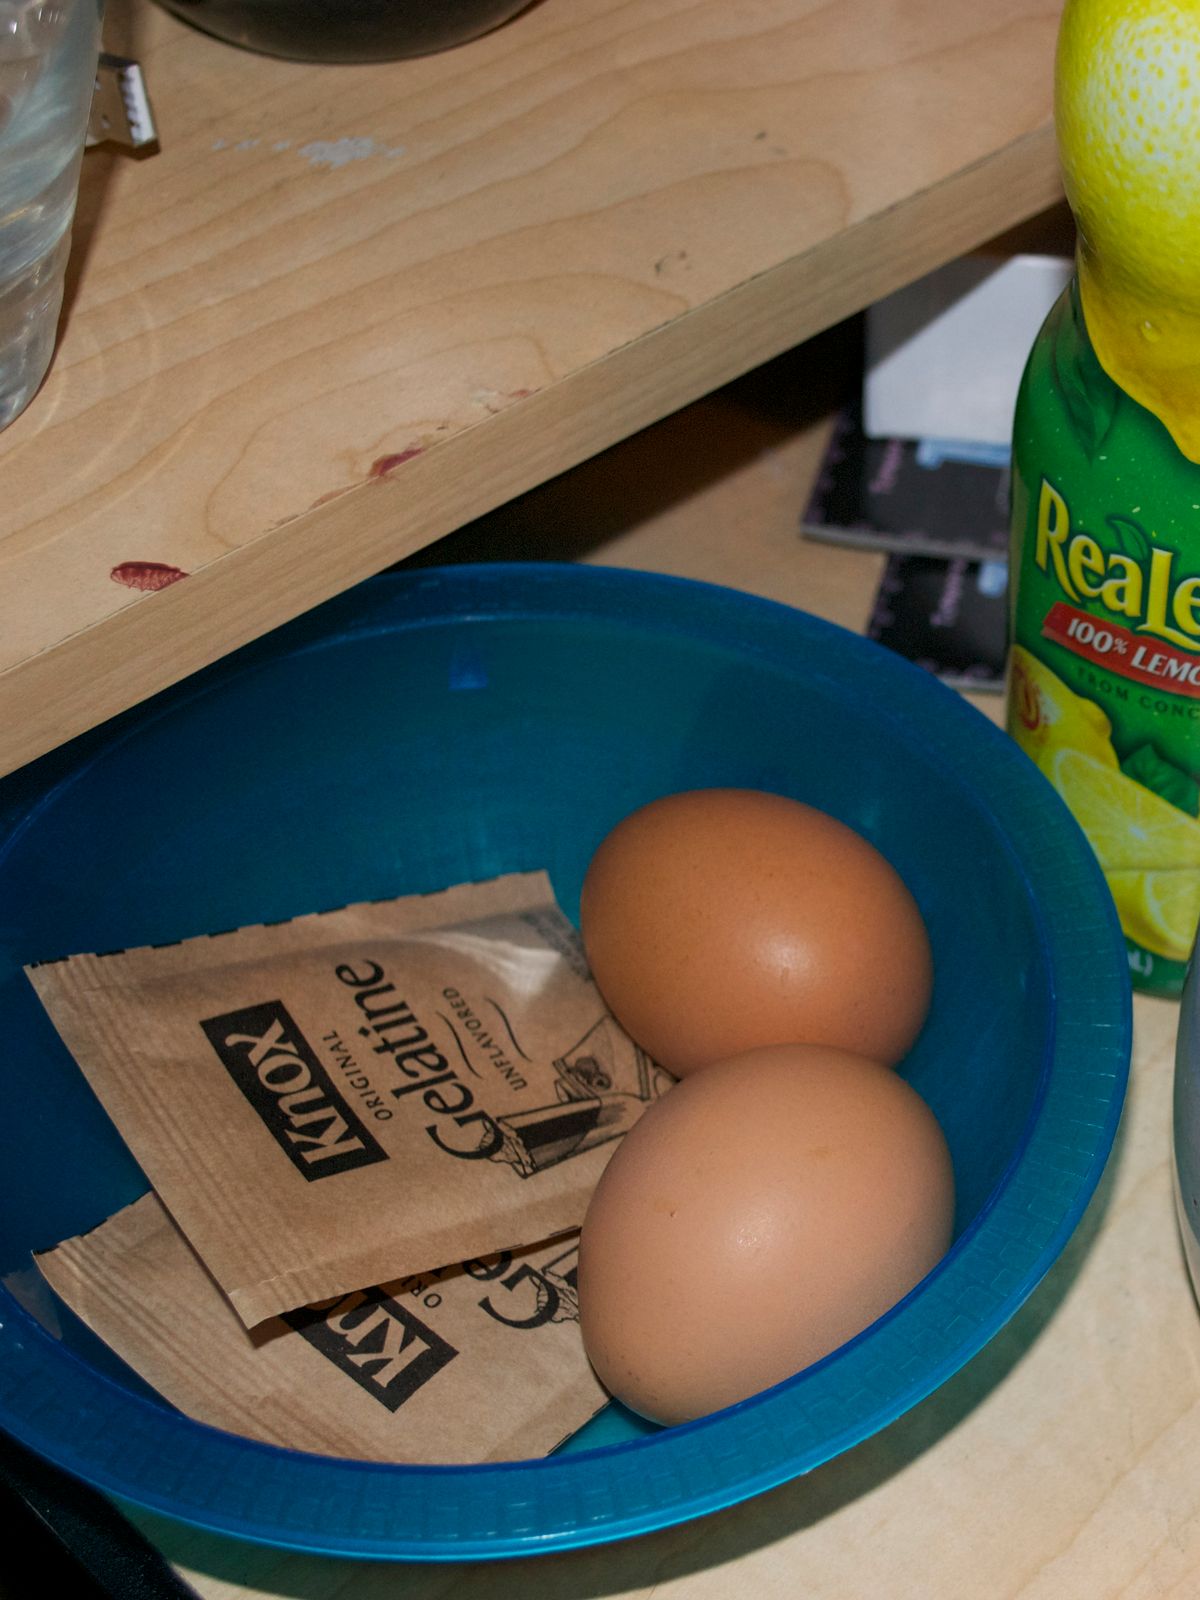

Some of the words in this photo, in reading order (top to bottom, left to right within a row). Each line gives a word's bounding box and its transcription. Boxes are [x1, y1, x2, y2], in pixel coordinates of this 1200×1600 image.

[1067, 618, 1129, 655] 100%
[1078, 667, 1128, 701] FROM
[322, 1029, 393, 1121] ORIGINAL
[335, 959, 503, 1160] Gelatine
[442, 987, 529, 1092] UNFLAVORED
[225, 1018, 366, 1167] Knox
